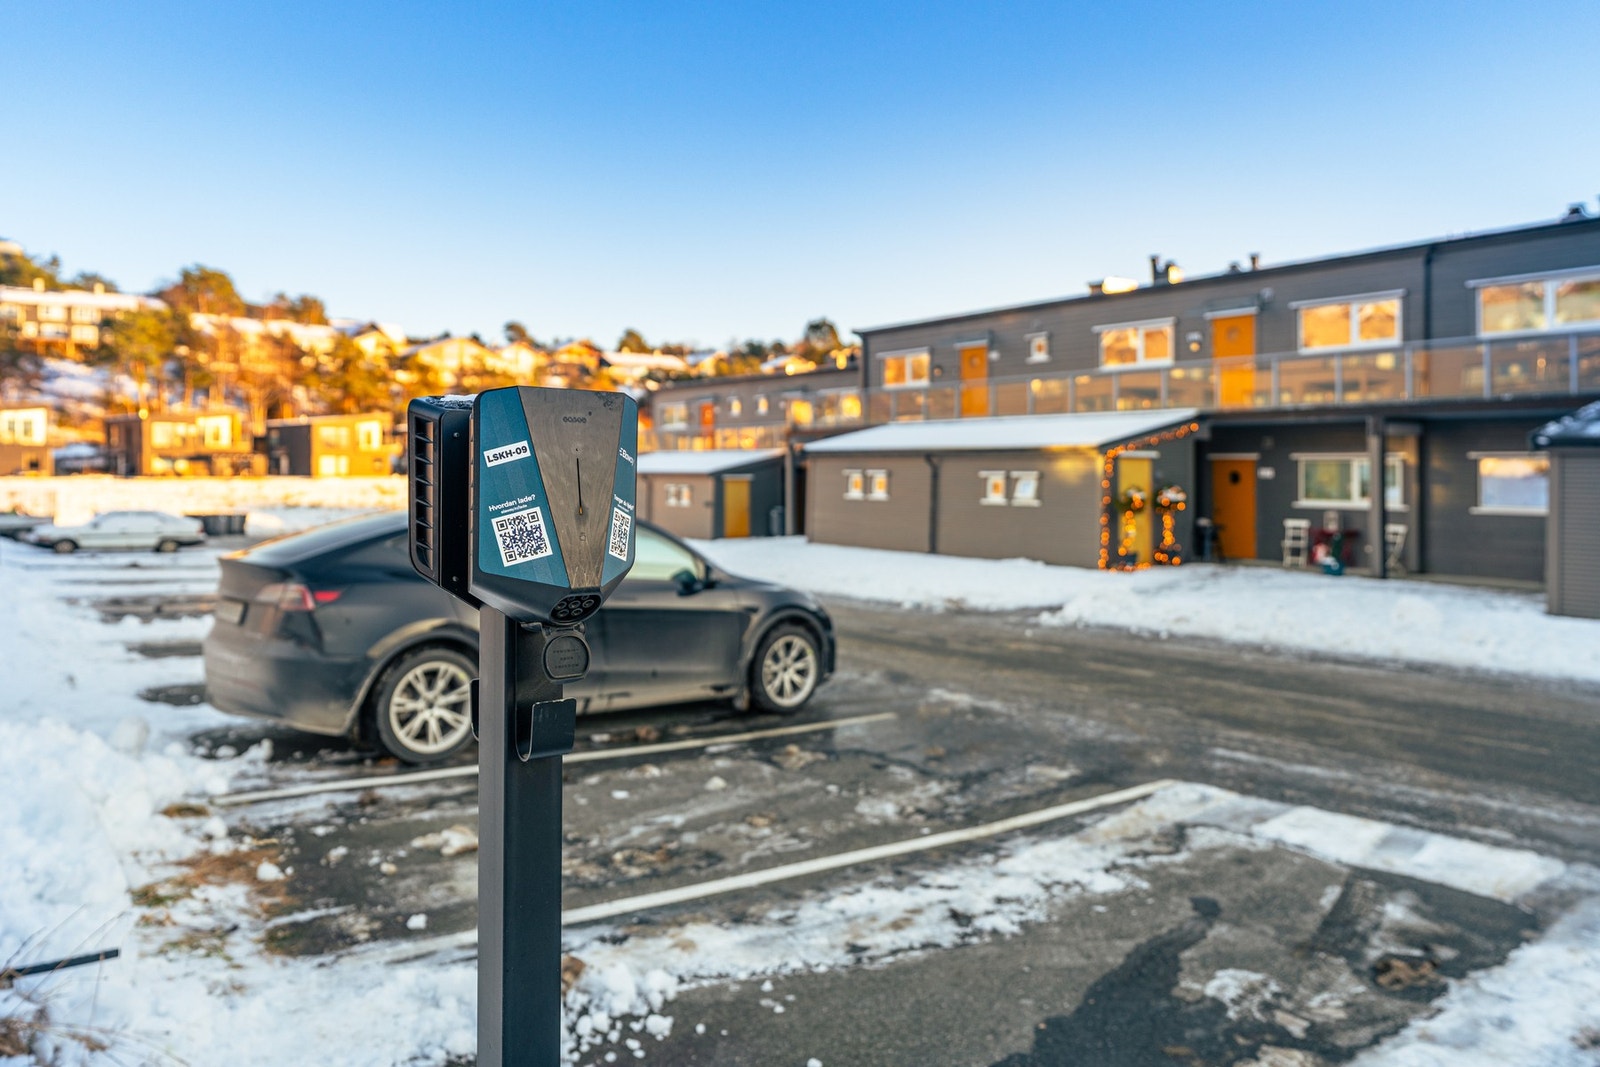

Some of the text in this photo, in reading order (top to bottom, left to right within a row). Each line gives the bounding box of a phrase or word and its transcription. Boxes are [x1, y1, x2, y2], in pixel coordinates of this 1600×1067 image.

[487, 446, 528, 463] LSKH-09
[488, 500, 517, 512] Hvordan
[517, 493, 536, 504] lade?
